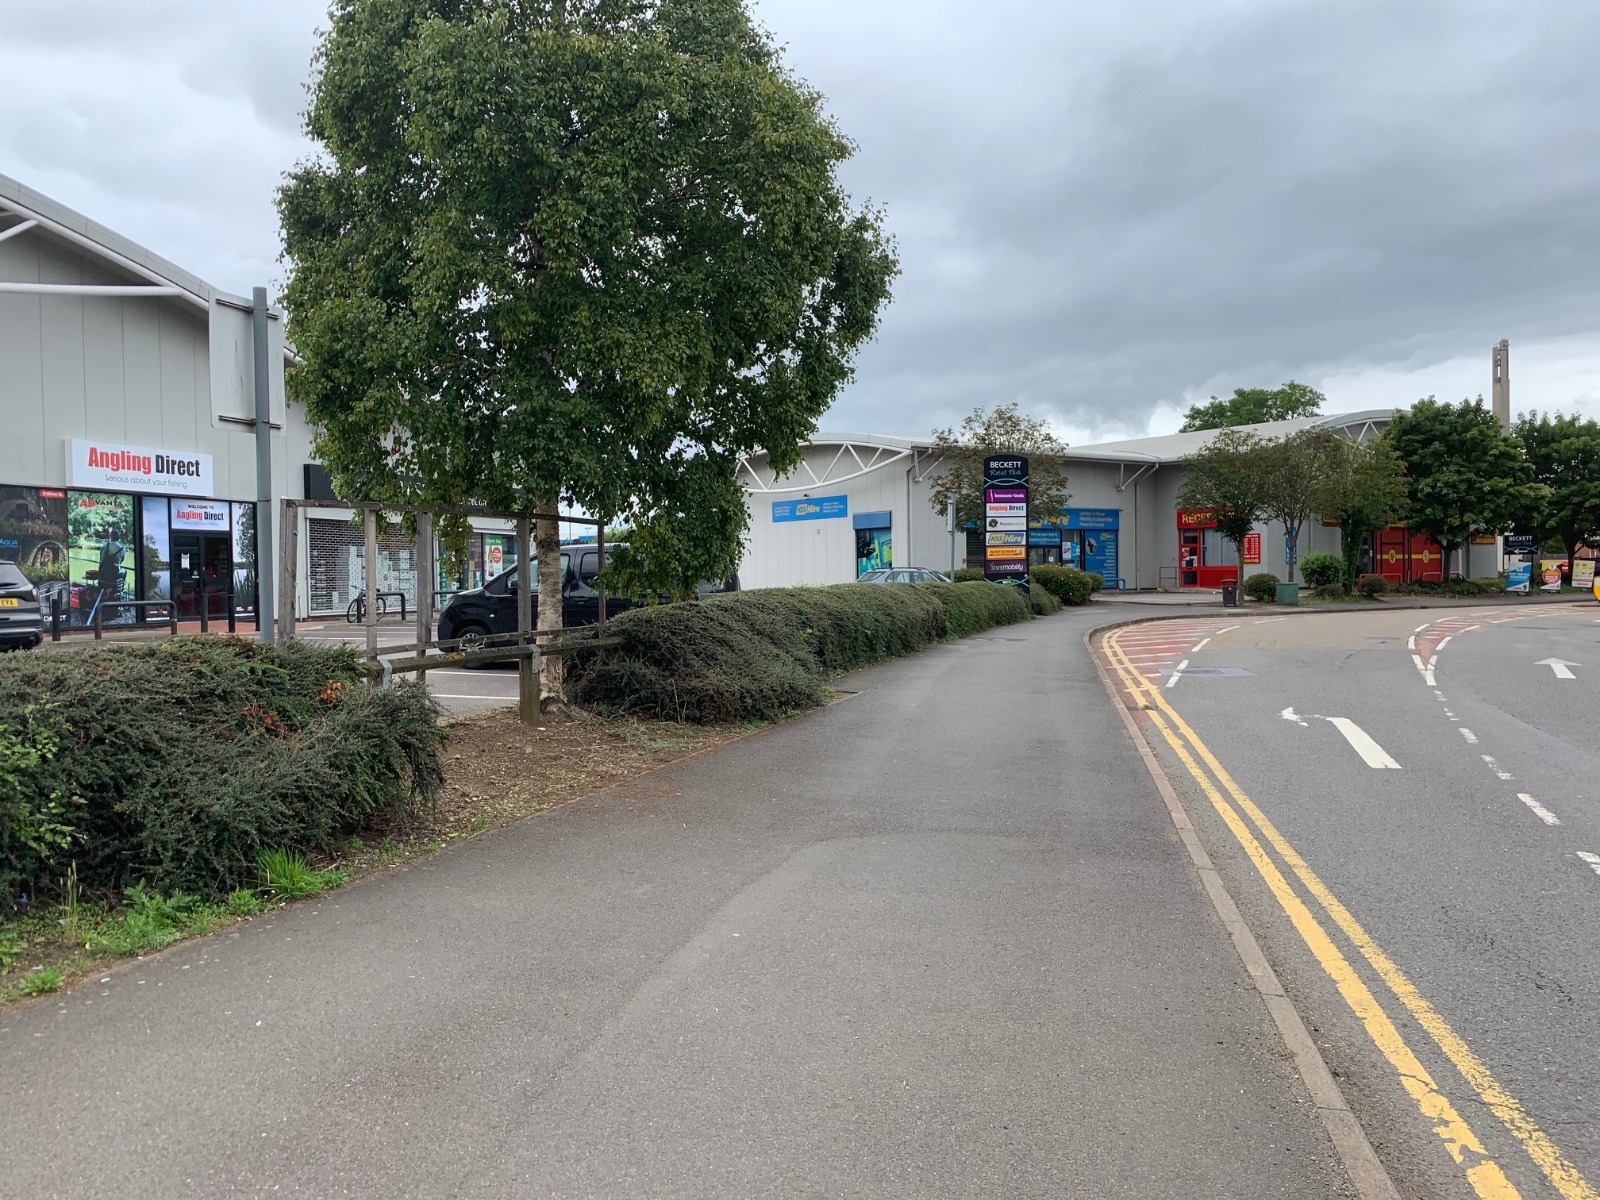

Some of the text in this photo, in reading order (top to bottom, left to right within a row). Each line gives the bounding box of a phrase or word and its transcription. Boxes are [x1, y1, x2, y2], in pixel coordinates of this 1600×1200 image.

[88, 447, 200, 477] Angling Direct
[104, 473, 188, 490] Serious about your fishing
[79, 498, 124, 508] ADVANTA
[176, 509, 224, 521] Angling Direct
[1004, 534, 1022, 543] Hire
